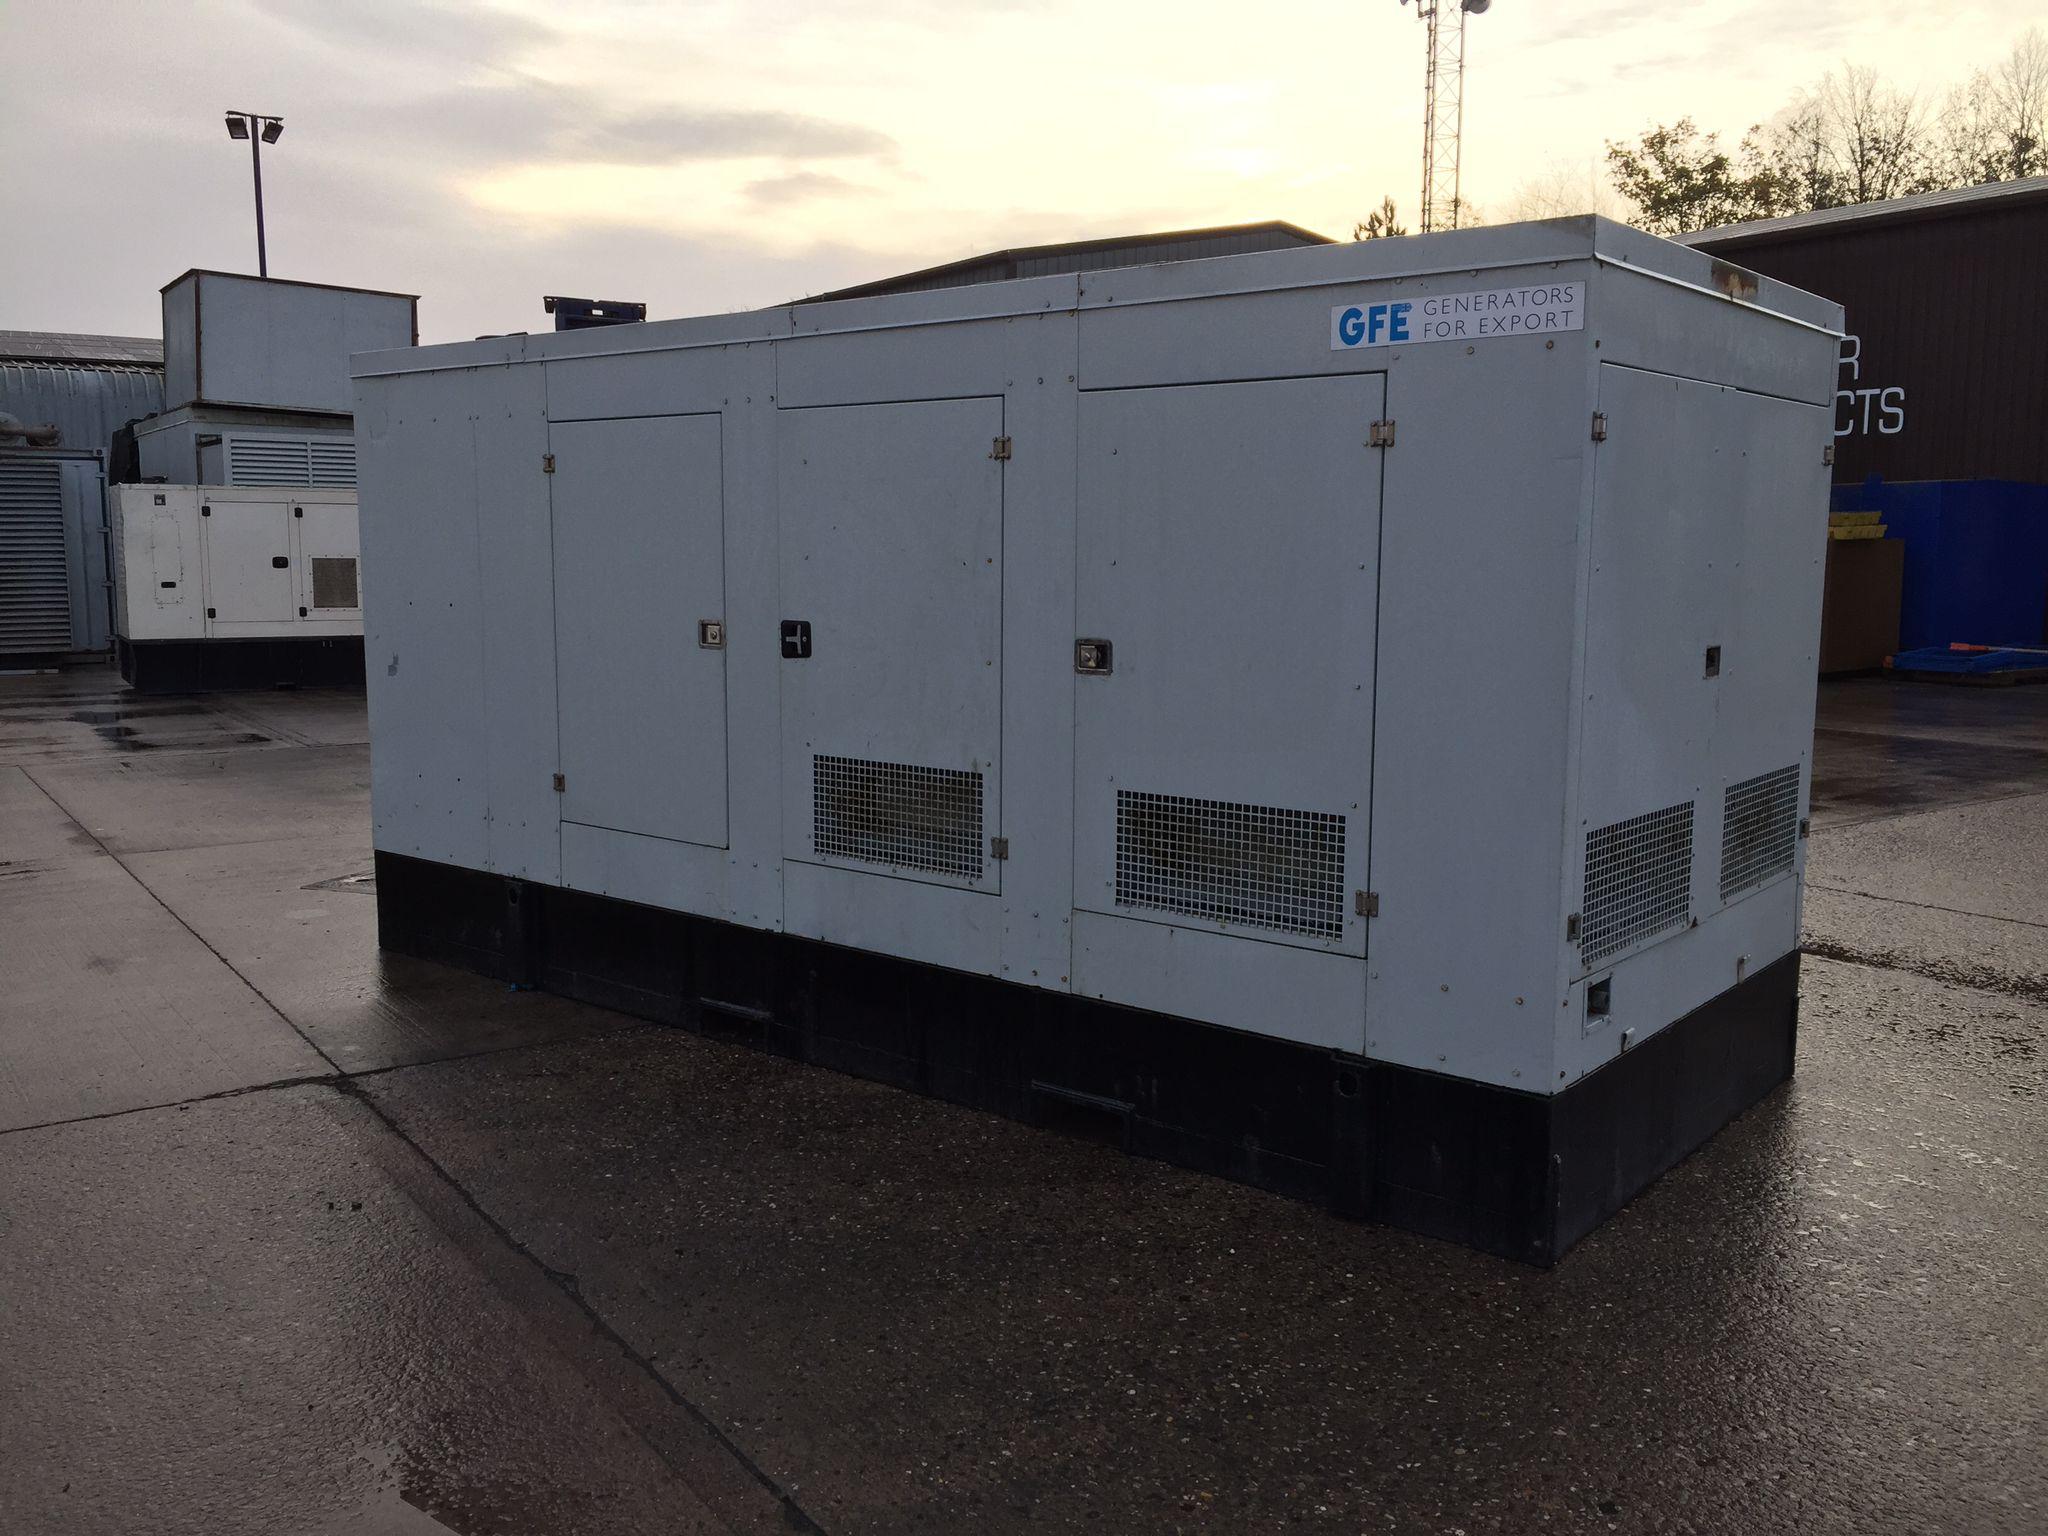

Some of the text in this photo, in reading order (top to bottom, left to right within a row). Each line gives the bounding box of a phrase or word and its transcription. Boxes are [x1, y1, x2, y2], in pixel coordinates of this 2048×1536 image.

[1423, 286, 1574, 316] GENERATORS
[1339, 303, 1412, 346] GFE
[1424, 310, 1574, 339] FOR EXPORT
